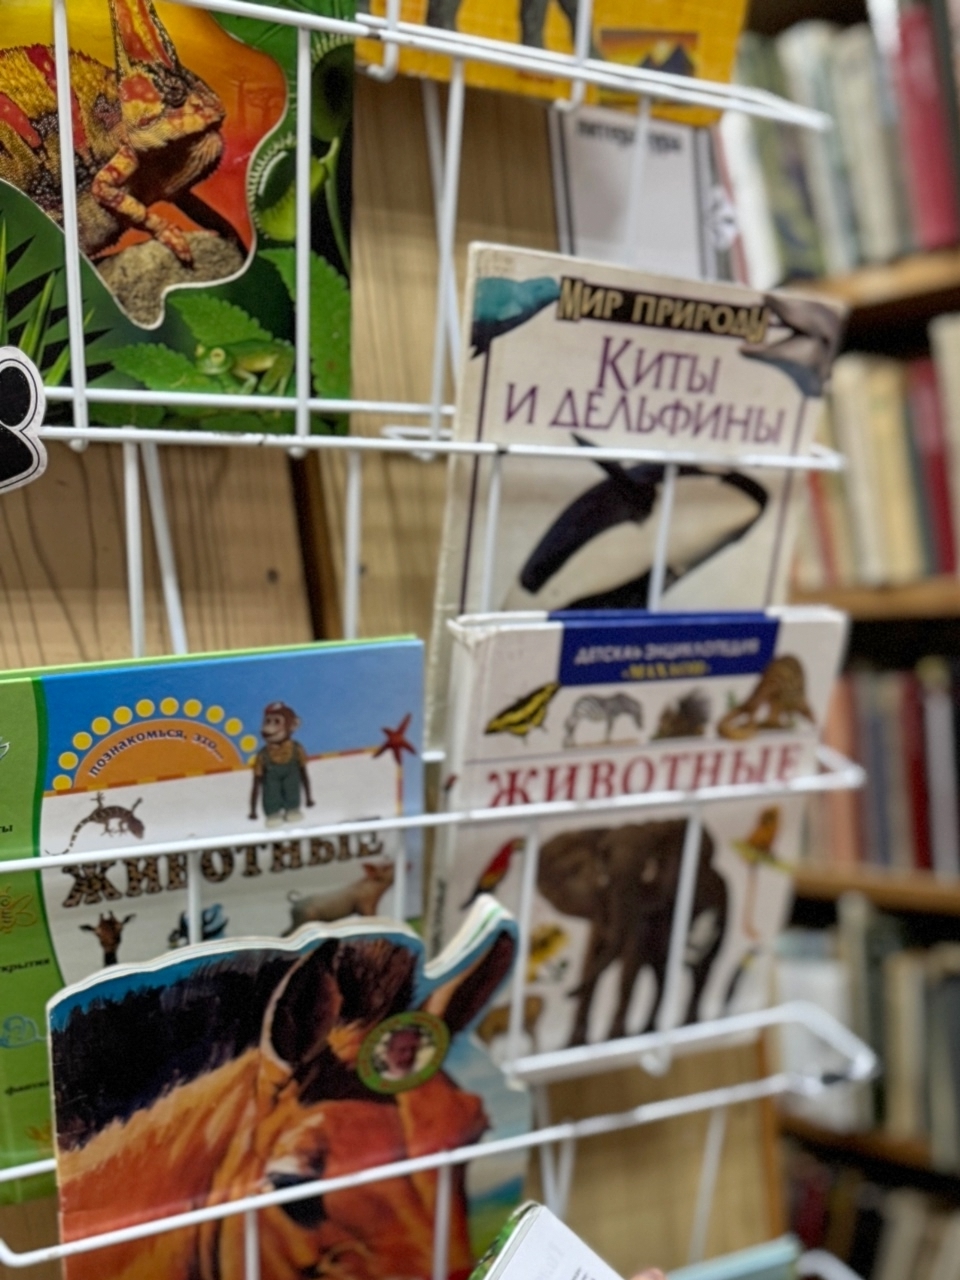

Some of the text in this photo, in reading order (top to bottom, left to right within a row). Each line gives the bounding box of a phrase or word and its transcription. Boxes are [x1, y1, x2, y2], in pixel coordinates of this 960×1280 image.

[504, 382, 786, 444] И ДЕЛЬФИНЫ
[88, 727, 188, 778] познакомься,
[487, 742, 803, 808] ЖИВОТНЫЕ
[62, 817, 384, 908] ЖИВОТНЫЕ
